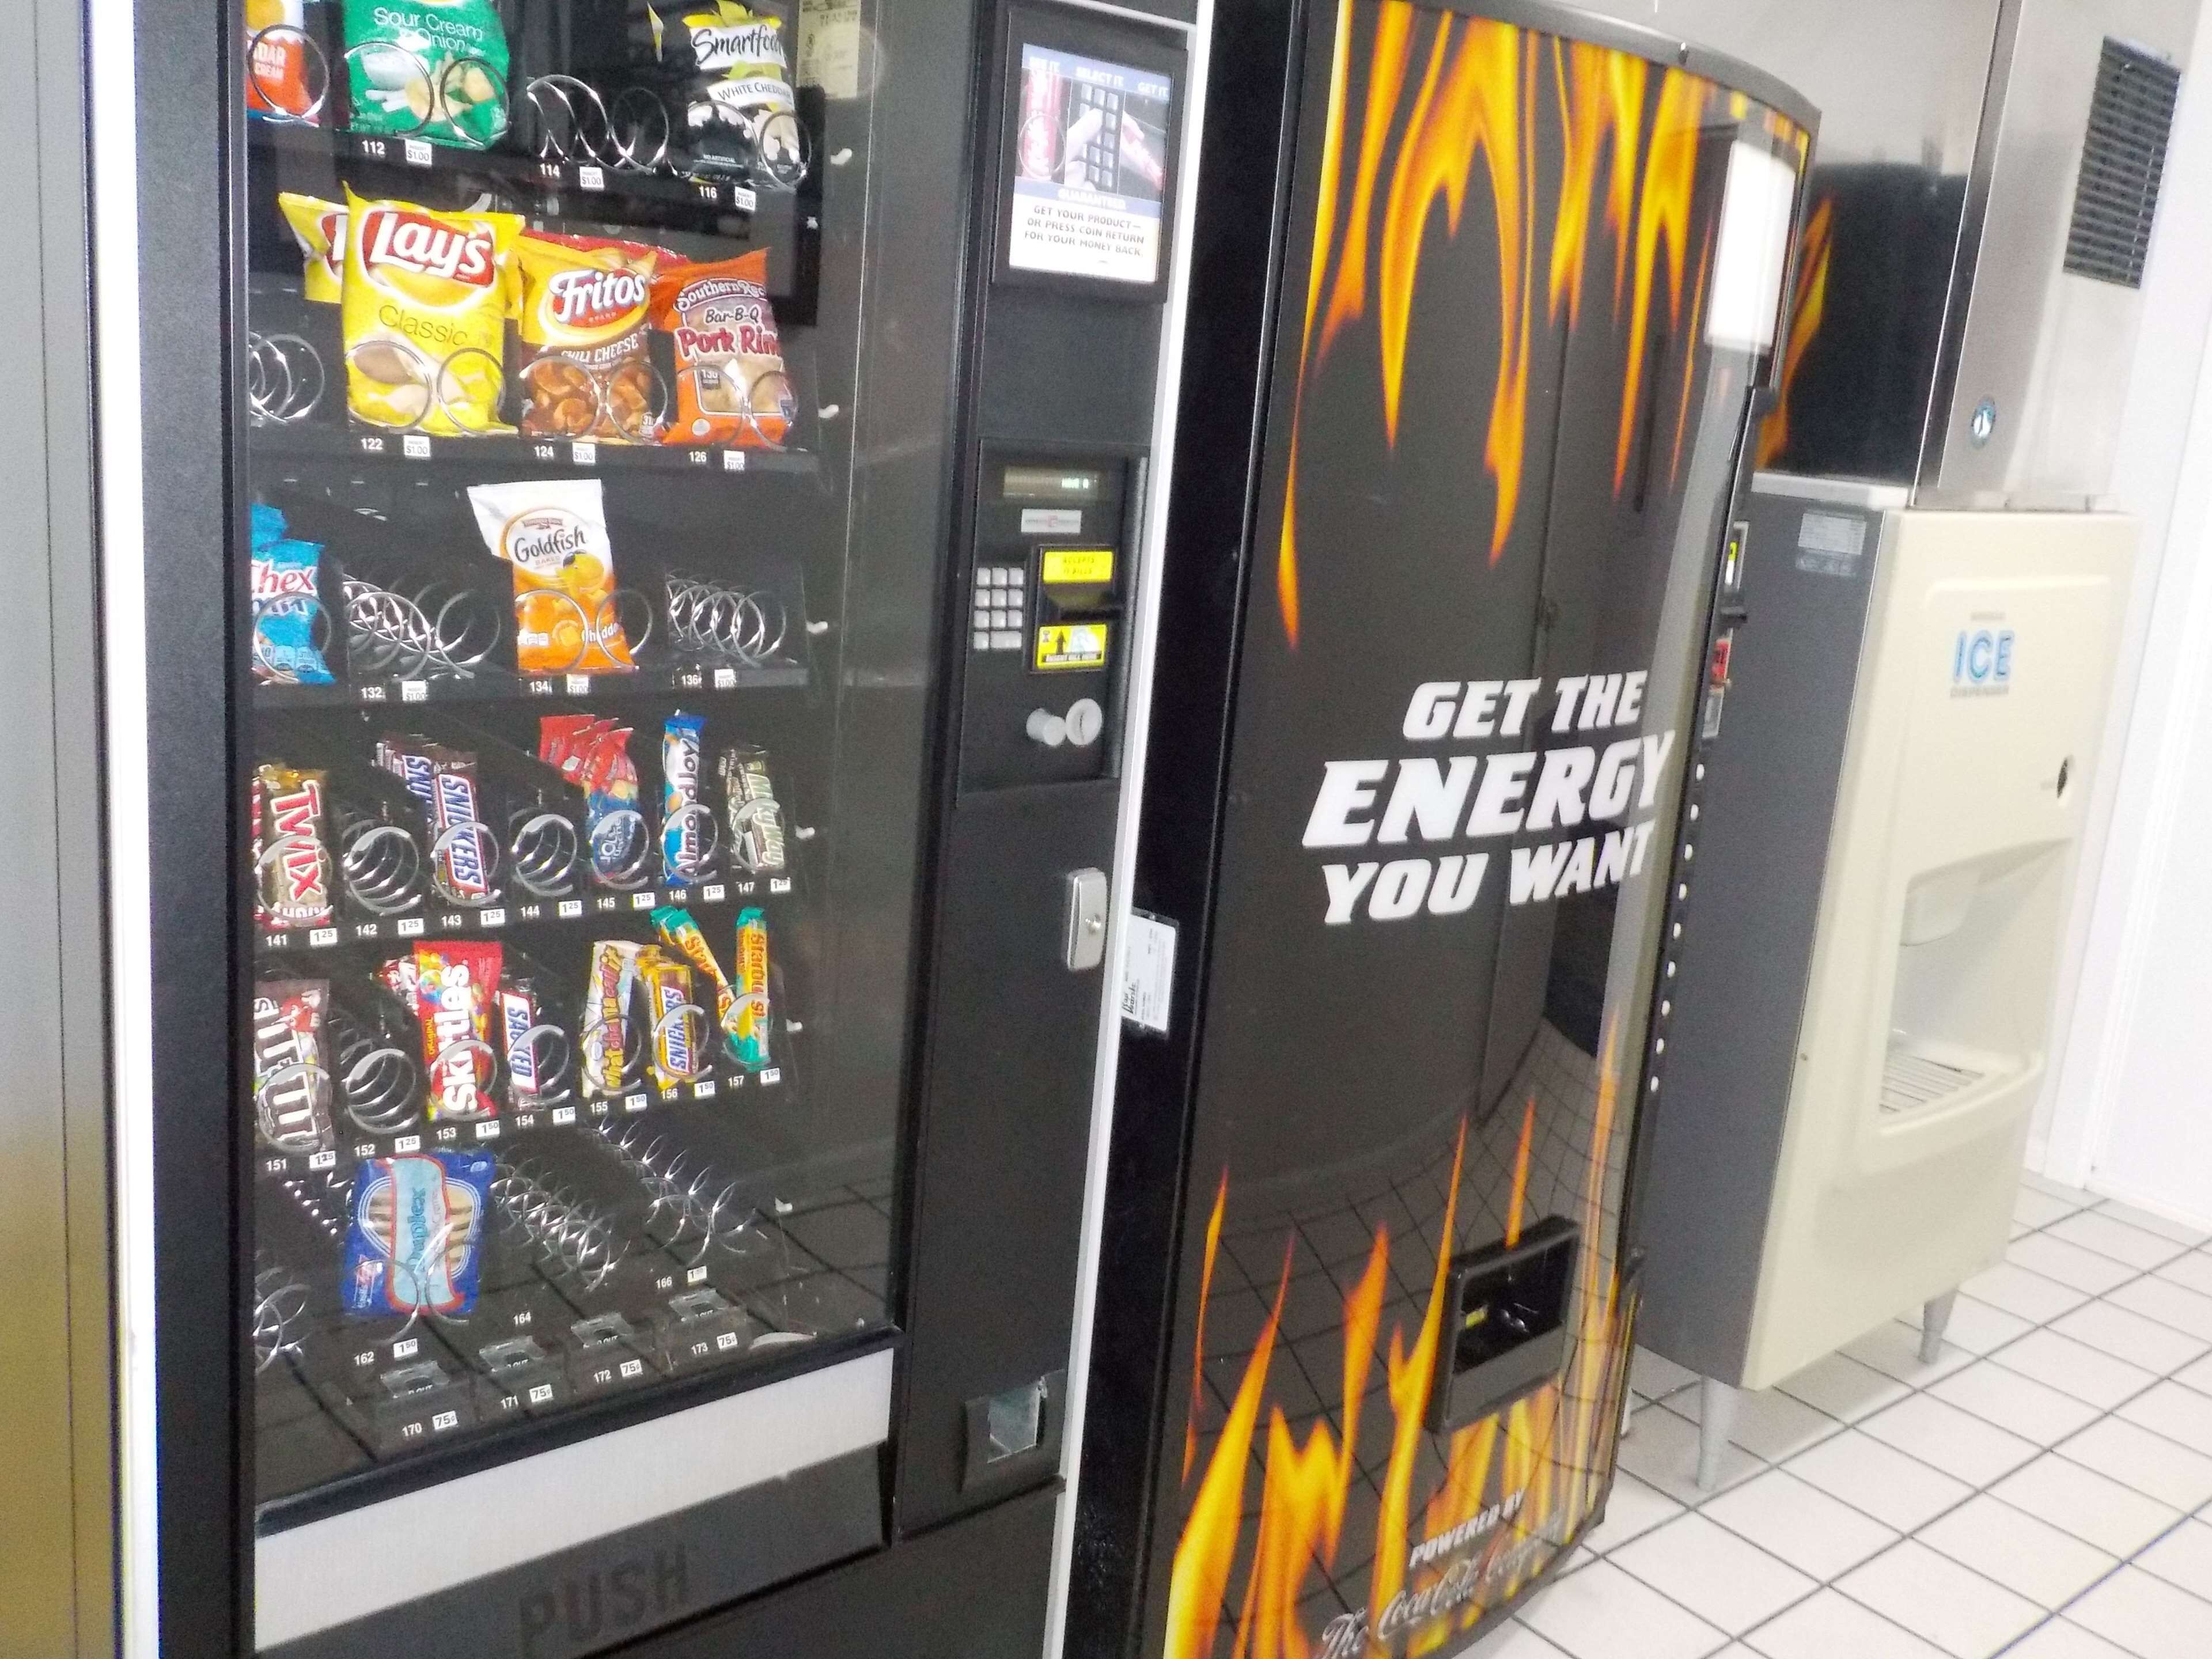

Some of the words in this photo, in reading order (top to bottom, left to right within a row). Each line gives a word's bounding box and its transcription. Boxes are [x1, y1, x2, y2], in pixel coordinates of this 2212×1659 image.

[374, 7, 421, 26] Sour
[426, 14, 483, 41] Cream
[718, 85, 751, 101] WHITE
[362, 139, 385, 155] 112
[407, 150, 430, 161] $1.00
[540, 163, 560, 178] 114
[582, 176, 601, 185] $1.00
[699, 185, 717, 199] 116
[736, 197, 754, 208] $1.00
[1033, 205, 1053, 215] GET
[1057, 209, 1084, 222] YOUR
[1027, 217, 1041, 228] OR
[1045, 219, 1075, 232] PRESS
[1079, 226, 1103, 237] COIN
[1105, 230, 1144, 244] RETURN
[369, 213, 491, 278] Lay's
[1024, 230, 1043, 241] FOR
[1048, 233, 1075, 245] YOUR
[1080, 238, 1112, 252] MONEY
[549, 268, 646, 324] Fritos
[676, 279, 741, 312] Southern
[704, 307, 760, 324] Bar-B-Q
[378, 304, 468, 346] Classic
[594, 332, 639, 363] CHEESE
[676, 327, 736, 358] Pork
[361, 437, 383, 450] 122
[406, 445, 428, 454] $1.00
[534, 446, 554, 457] 124
[574, 452, 593, 461] $1.00
[689, 451, 707, 462] 126
[514, 525, 586, 563] Goldfish
[1953, 630, 2015, 684] ICE
[681, 673, 699, 685] 136
[529, 680, 549, 692] 134
[361, 687, 383, 699] 132
[1403, 677, 1541, 740] GET
[1551, 670, 1649, 733] THE
[1302, 730, 1676, 849] ENERGY
[1323, 853, 1489, 924] YOU
[1510, 820, 1657, 906] WANT
[738, 881, 755, 893] 147
[669, 889, 687, 900] 146
[597, 897, 616, 909] 145
[520, 905, 540, 918] 144
[441, 915, 461, 926] 143
[355, 923, 378, 936] 142
[266, 934, 287, 946] 141
[751, 933, 766, 1018] Starbust
[664, 988, 687, 1069] SNICKRS
[728, 1075, 744, 1086] 157
[661, 1088, 678, 1100] 156
[590, 1101, 608, 1113] 155
[515, 1114, 535, 1126] 154
[436, 1127, 456, 1140] 153
[354, 1144, 376, 1157] 152
[266, 1158, 287, 1171] 151
[655, 1276, 673, 1289] 166
[513, 1312, 531, 1325] 164
[691, 1342, 709, 1354] 173
[354, 1351, 374, 1365] 162
[593, 1369, 612, 1384] 172
[500, 1395, 518, 1409] 171
[402, 1422, 422, 1437] 170
[1408, 1503, 1500, 1570] POWERED
[518, 1543, 687, 1659] PUSH
